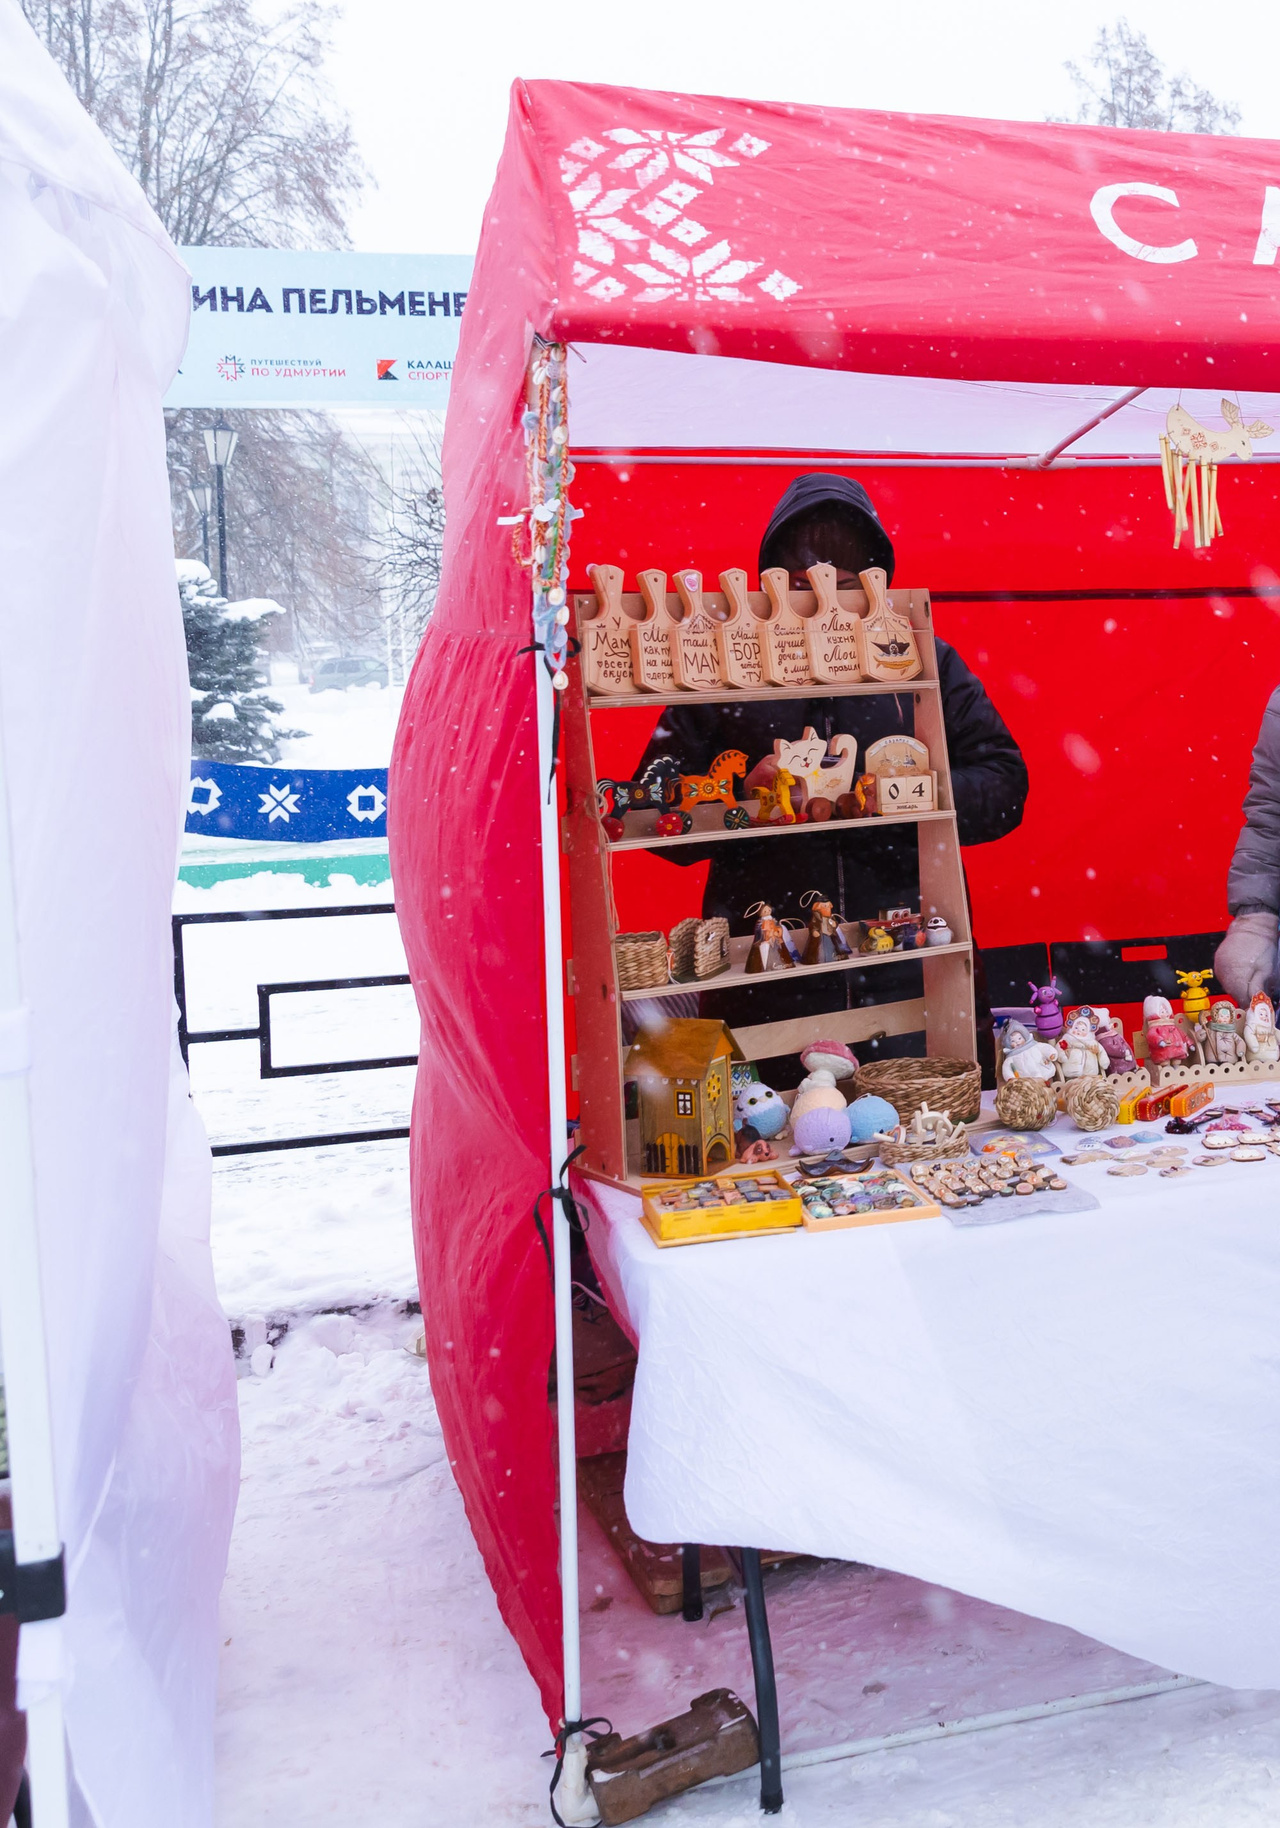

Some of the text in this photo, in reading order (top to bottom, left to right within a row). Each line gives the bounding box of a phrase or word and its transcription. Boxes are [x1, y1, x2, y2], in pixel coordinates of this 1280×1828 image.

[191, 285, 468, 317] ИНА ПЕЛЬМЕНЕ
[250, 358, 322, 366] ПУТЕШЕСТВУЙ
[251, 367, 346, 378] ПО УДМУРТИИ
[408, 371, 450, 381] СПОРТ
[821, 613, 854, 634] Моя
[823, 645, 857, 663] Мои
